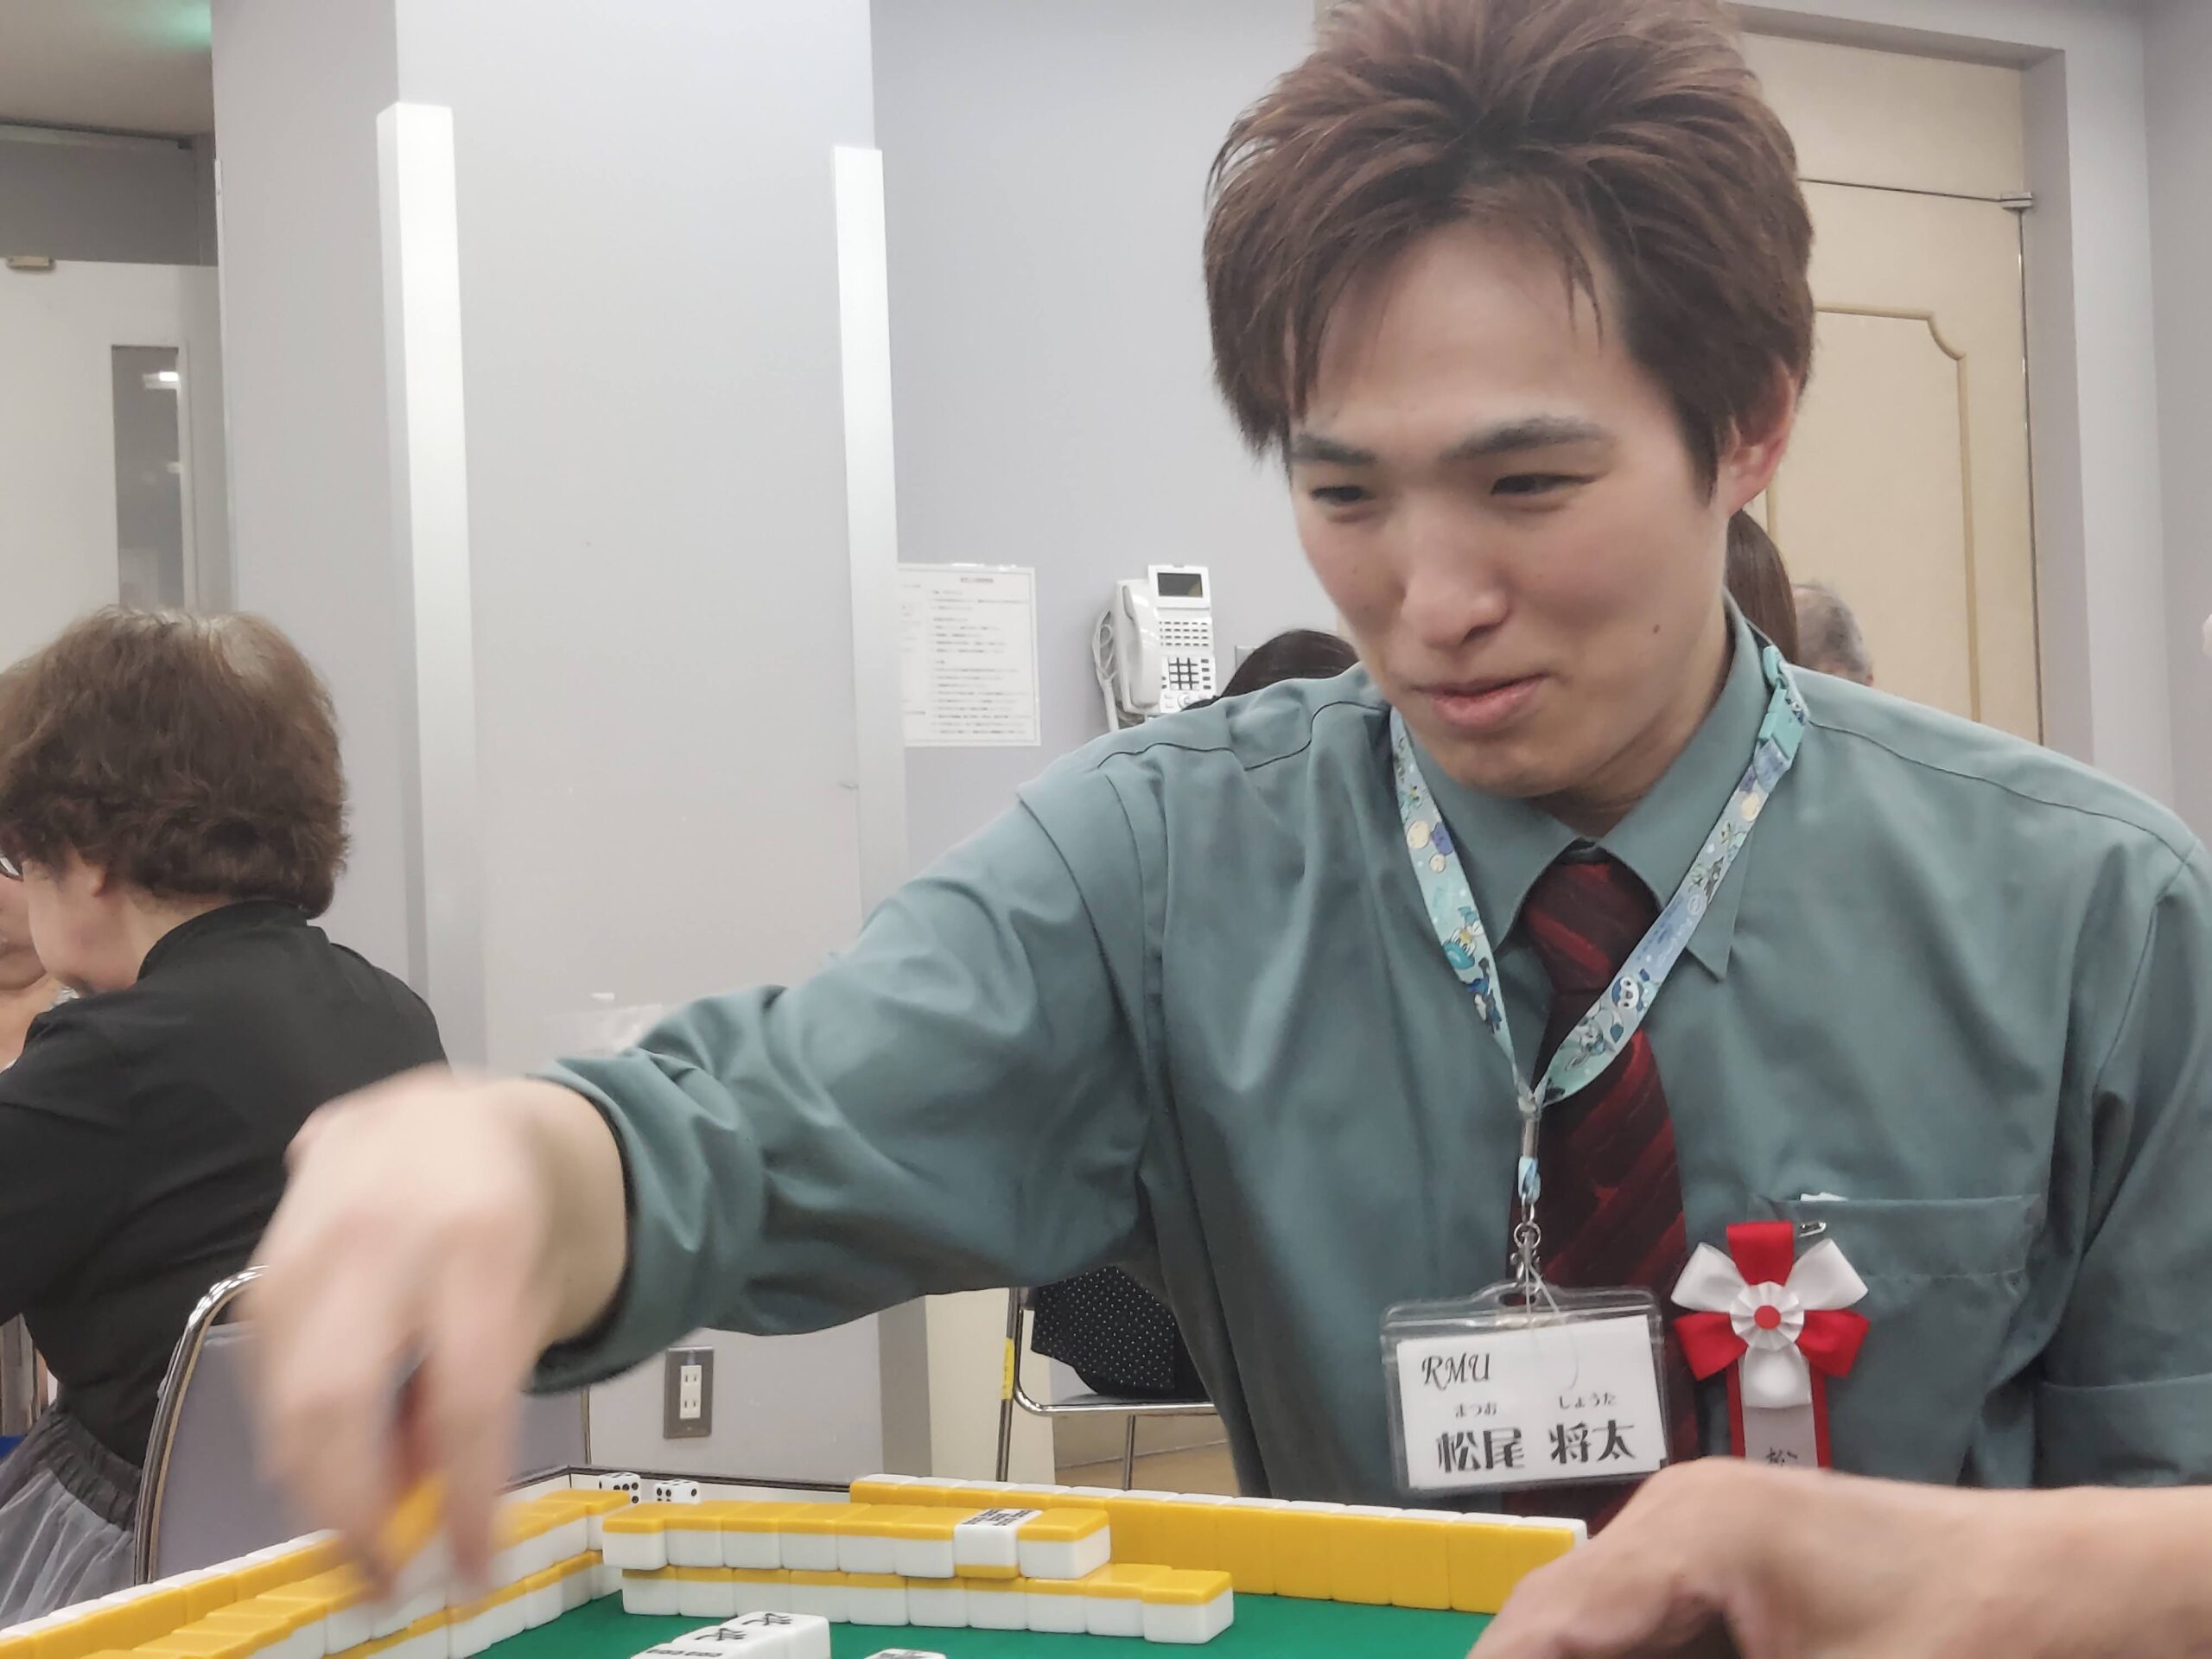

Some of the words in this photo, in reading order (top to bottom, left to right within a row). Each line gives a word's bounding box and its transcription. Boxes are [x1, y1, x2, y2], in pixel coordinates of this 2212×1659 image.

[1421, 1351, 1490, 1391] RMU
[1436, 1427, 1525, 1473] 松尾
[1549, 1420, 1636, 1465] 将太
